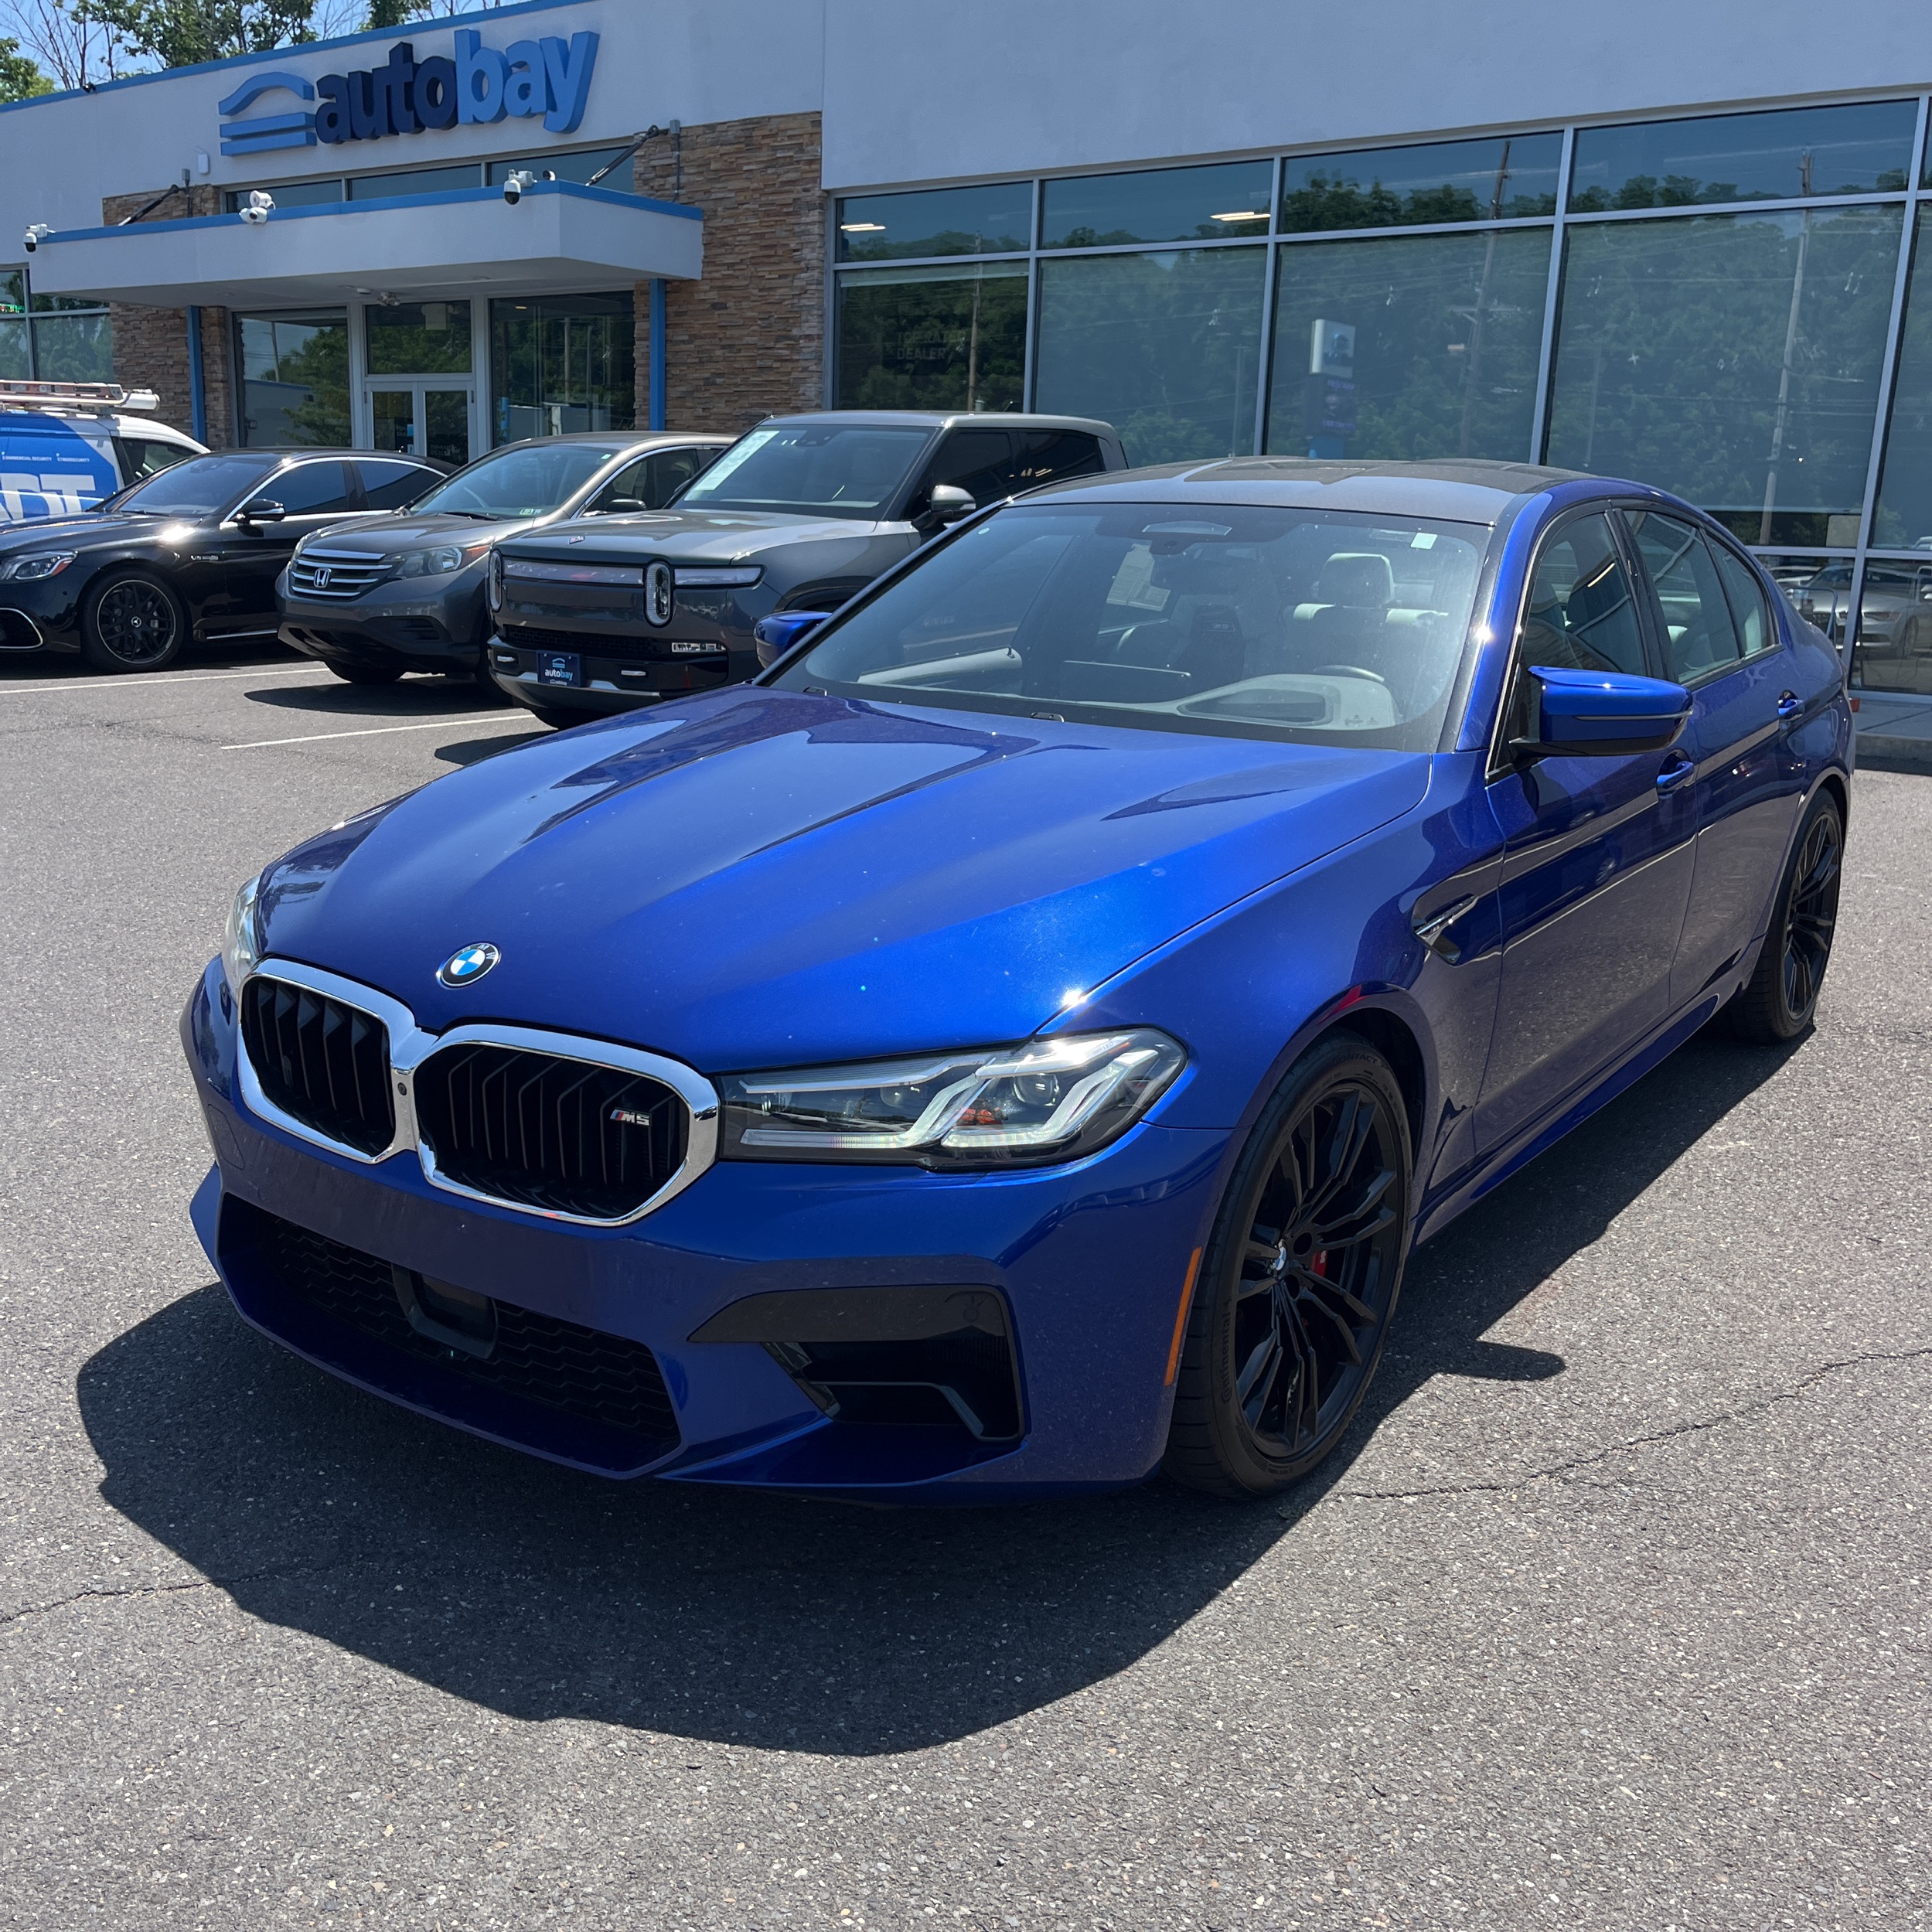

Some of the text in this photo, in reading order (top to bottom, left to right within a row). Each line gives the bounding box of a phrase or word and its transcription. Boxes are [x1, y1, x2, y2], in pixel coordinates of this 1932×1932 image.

[315, 29, 599, 144] autobay
[896, 347, 946, 359] DEALER
[0, 472, 96, 523] DT
[544, 669, 573, 681] autobay
[618, 1110, 650, 1126] M5
[1220, 1312, 1232, 1405] Continental
